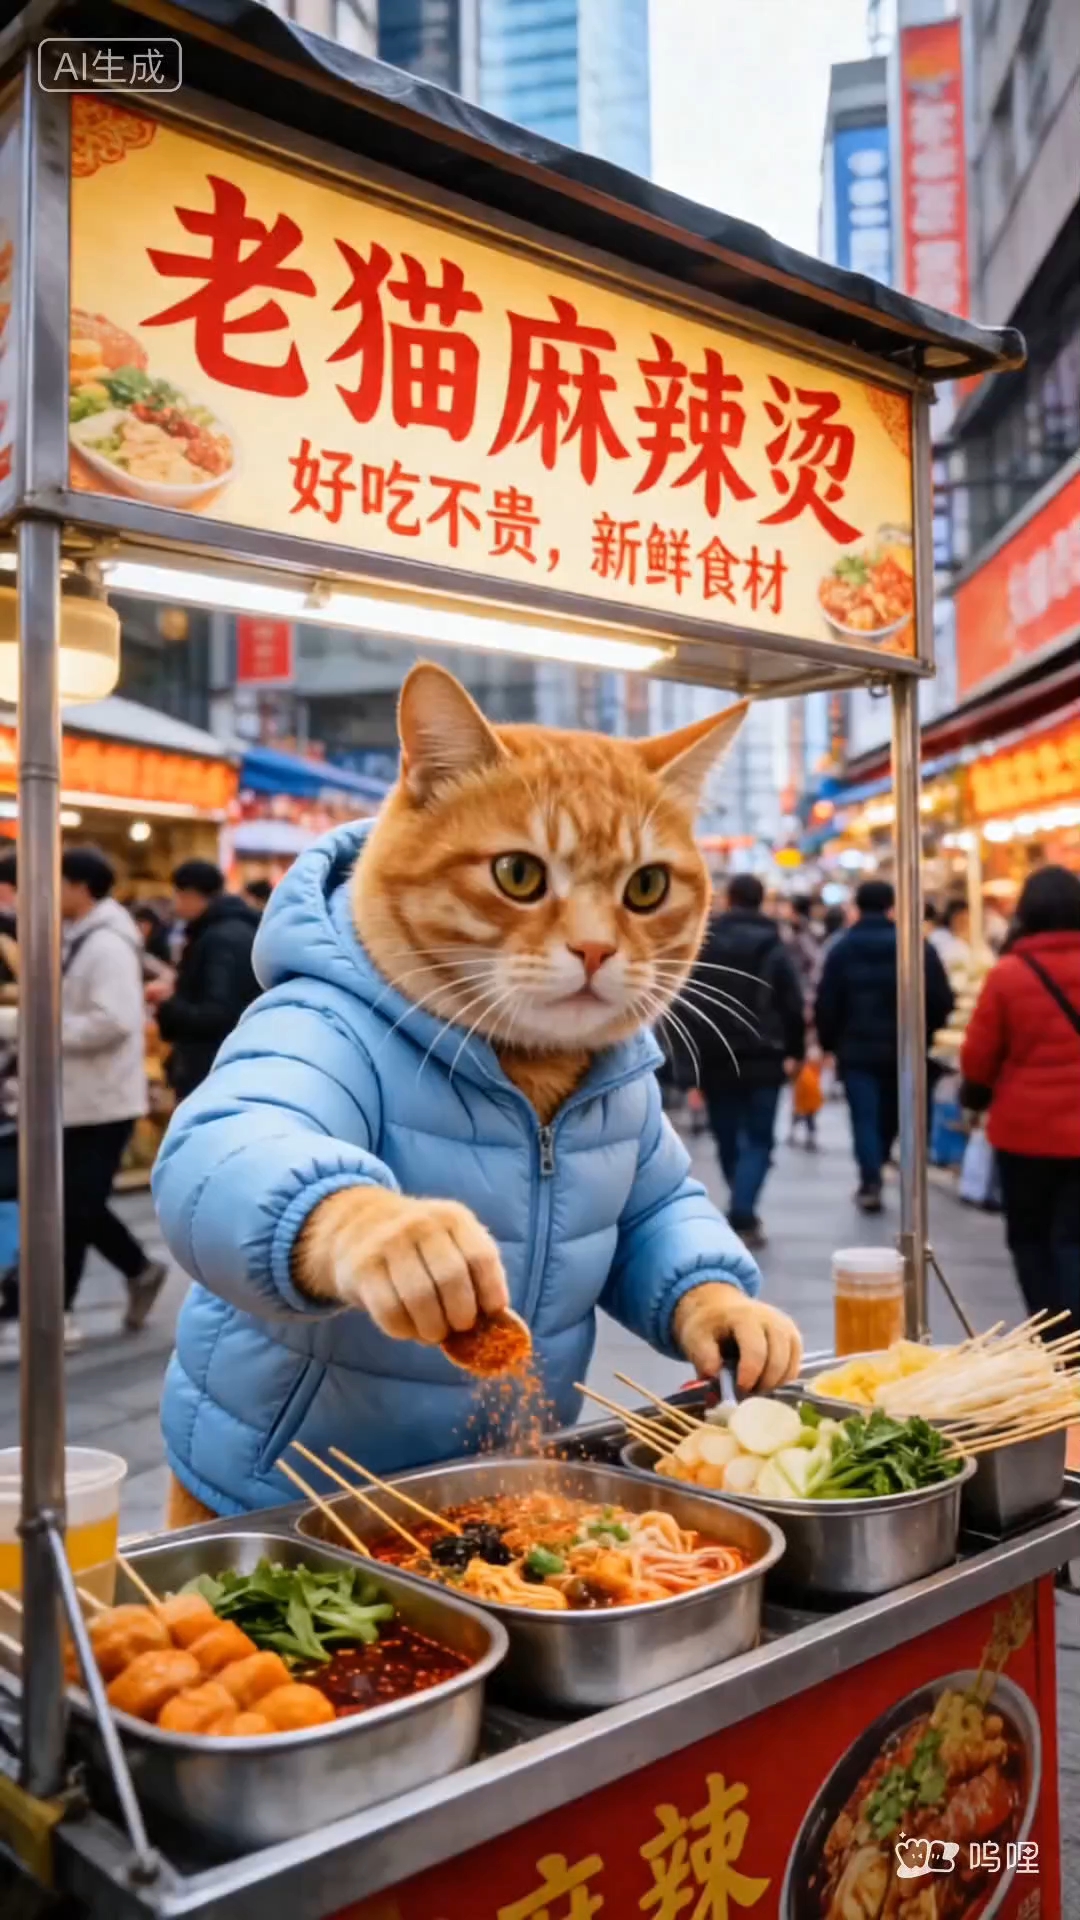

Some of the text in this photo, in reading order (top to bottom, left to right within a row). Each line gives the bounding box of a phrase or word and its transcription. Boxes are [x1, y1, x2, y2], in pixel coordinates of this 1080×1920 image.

[141, 175, 861, 545] 老猫麻辣烫
